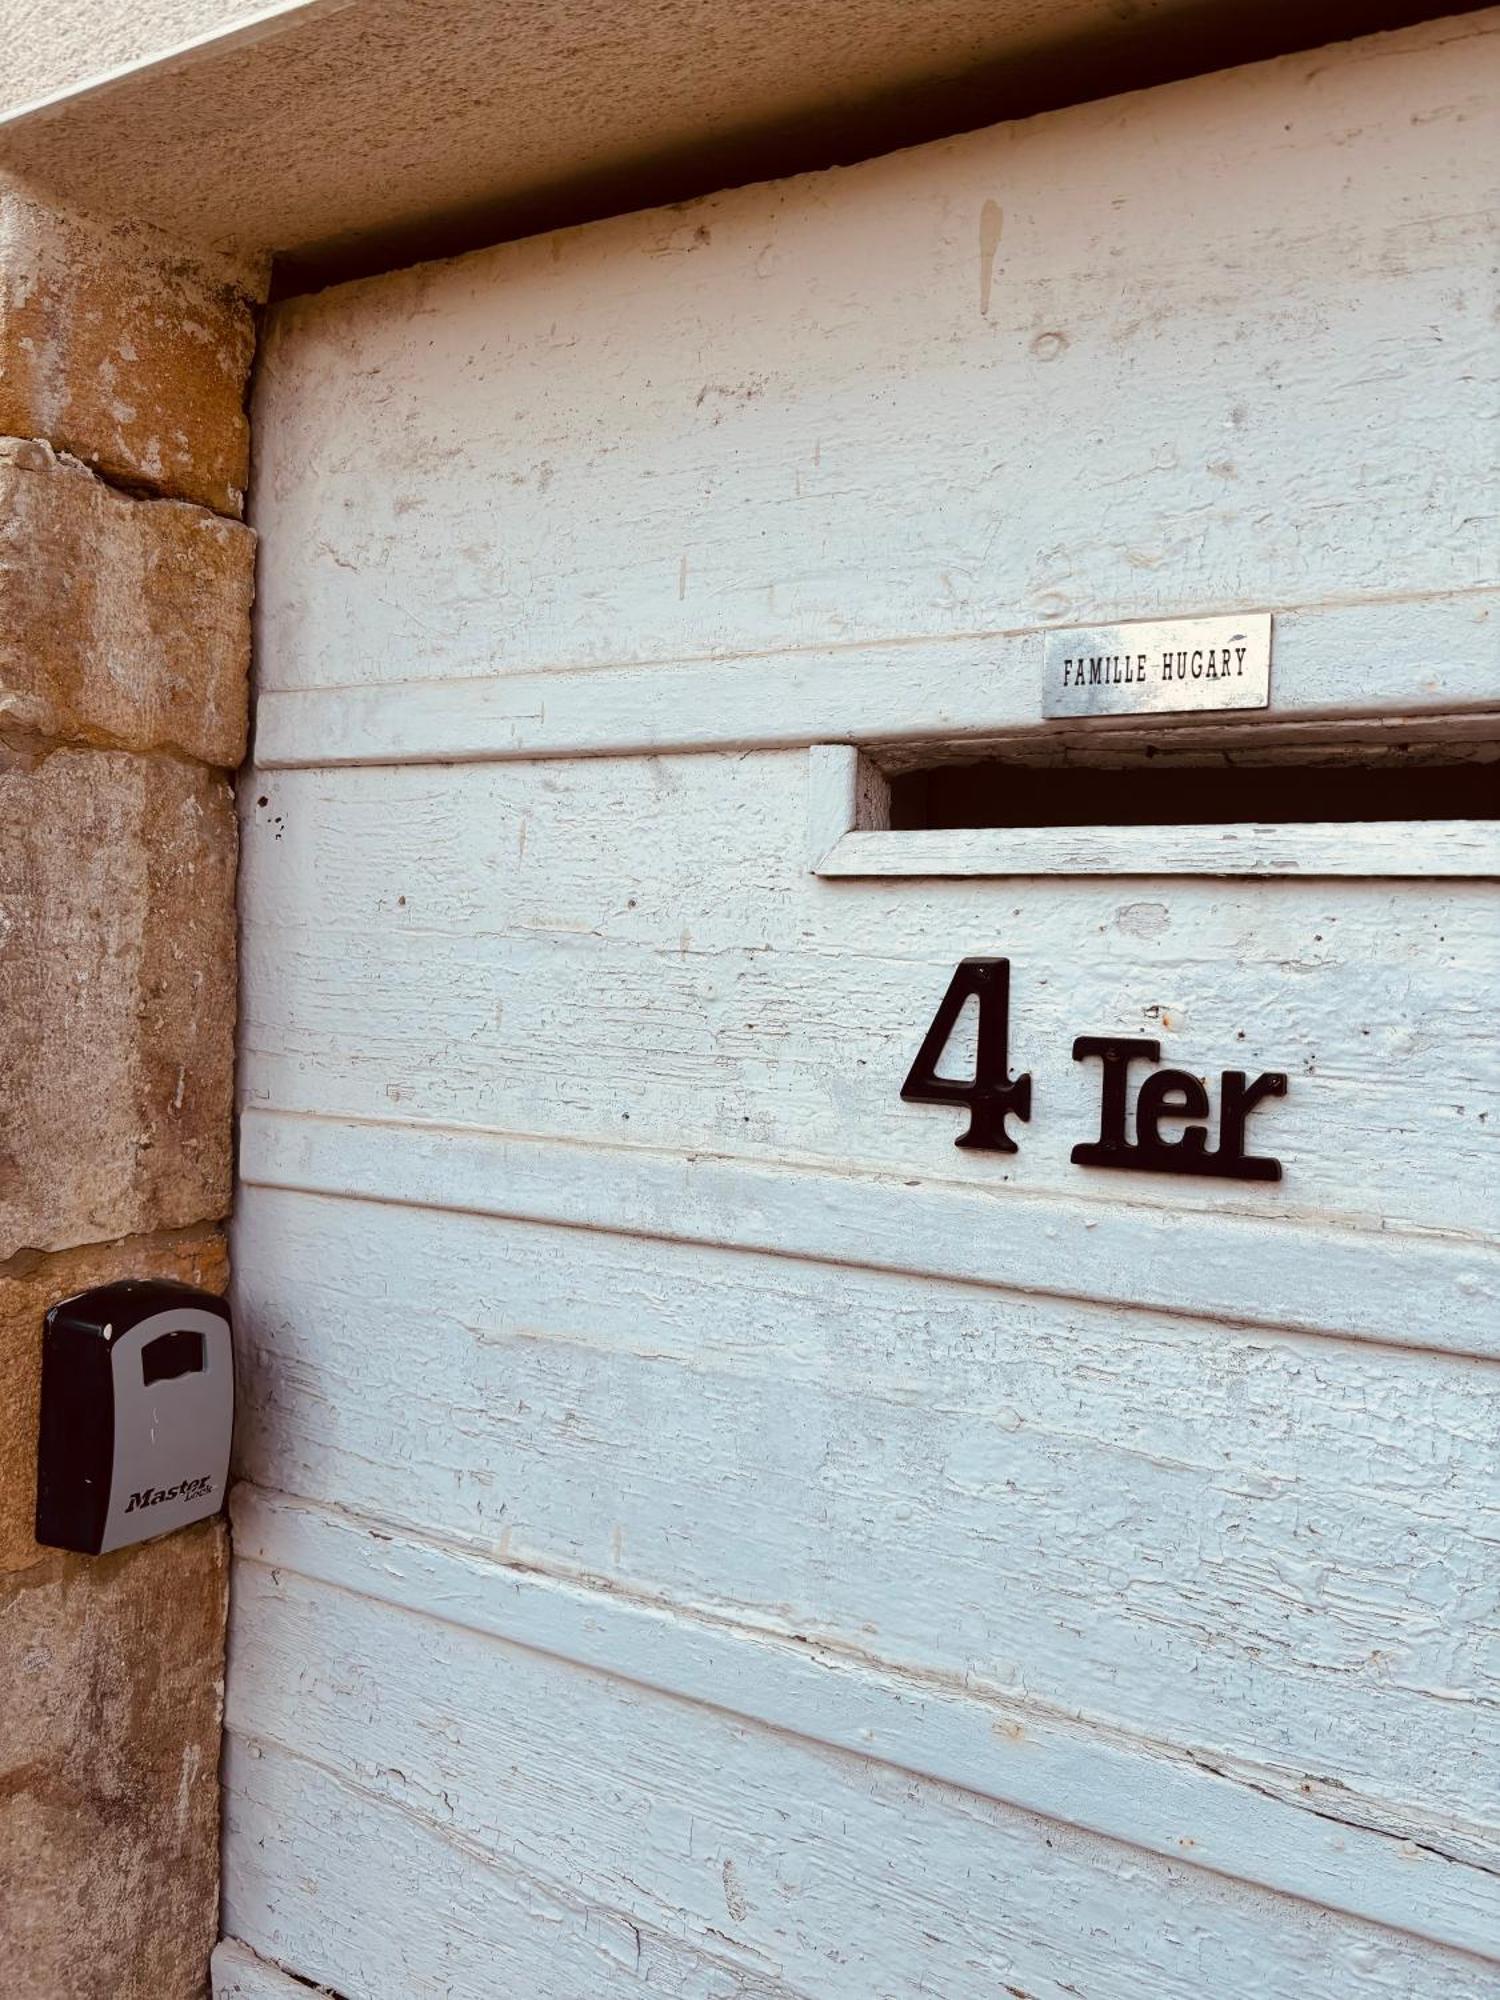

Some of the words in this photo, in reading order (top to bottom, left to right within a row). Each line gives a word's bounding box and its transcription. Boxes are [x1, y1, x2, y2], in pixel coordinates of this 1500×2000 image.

[1063, 654, 1147, 687] FAMILLE
[1162, 647, 1247, 681] HUGARY
[900, 957, 1032, 1154] 4
[1070, 1036, 1288, 1182] Ter
[124, 1474, 212, 1514] Master
